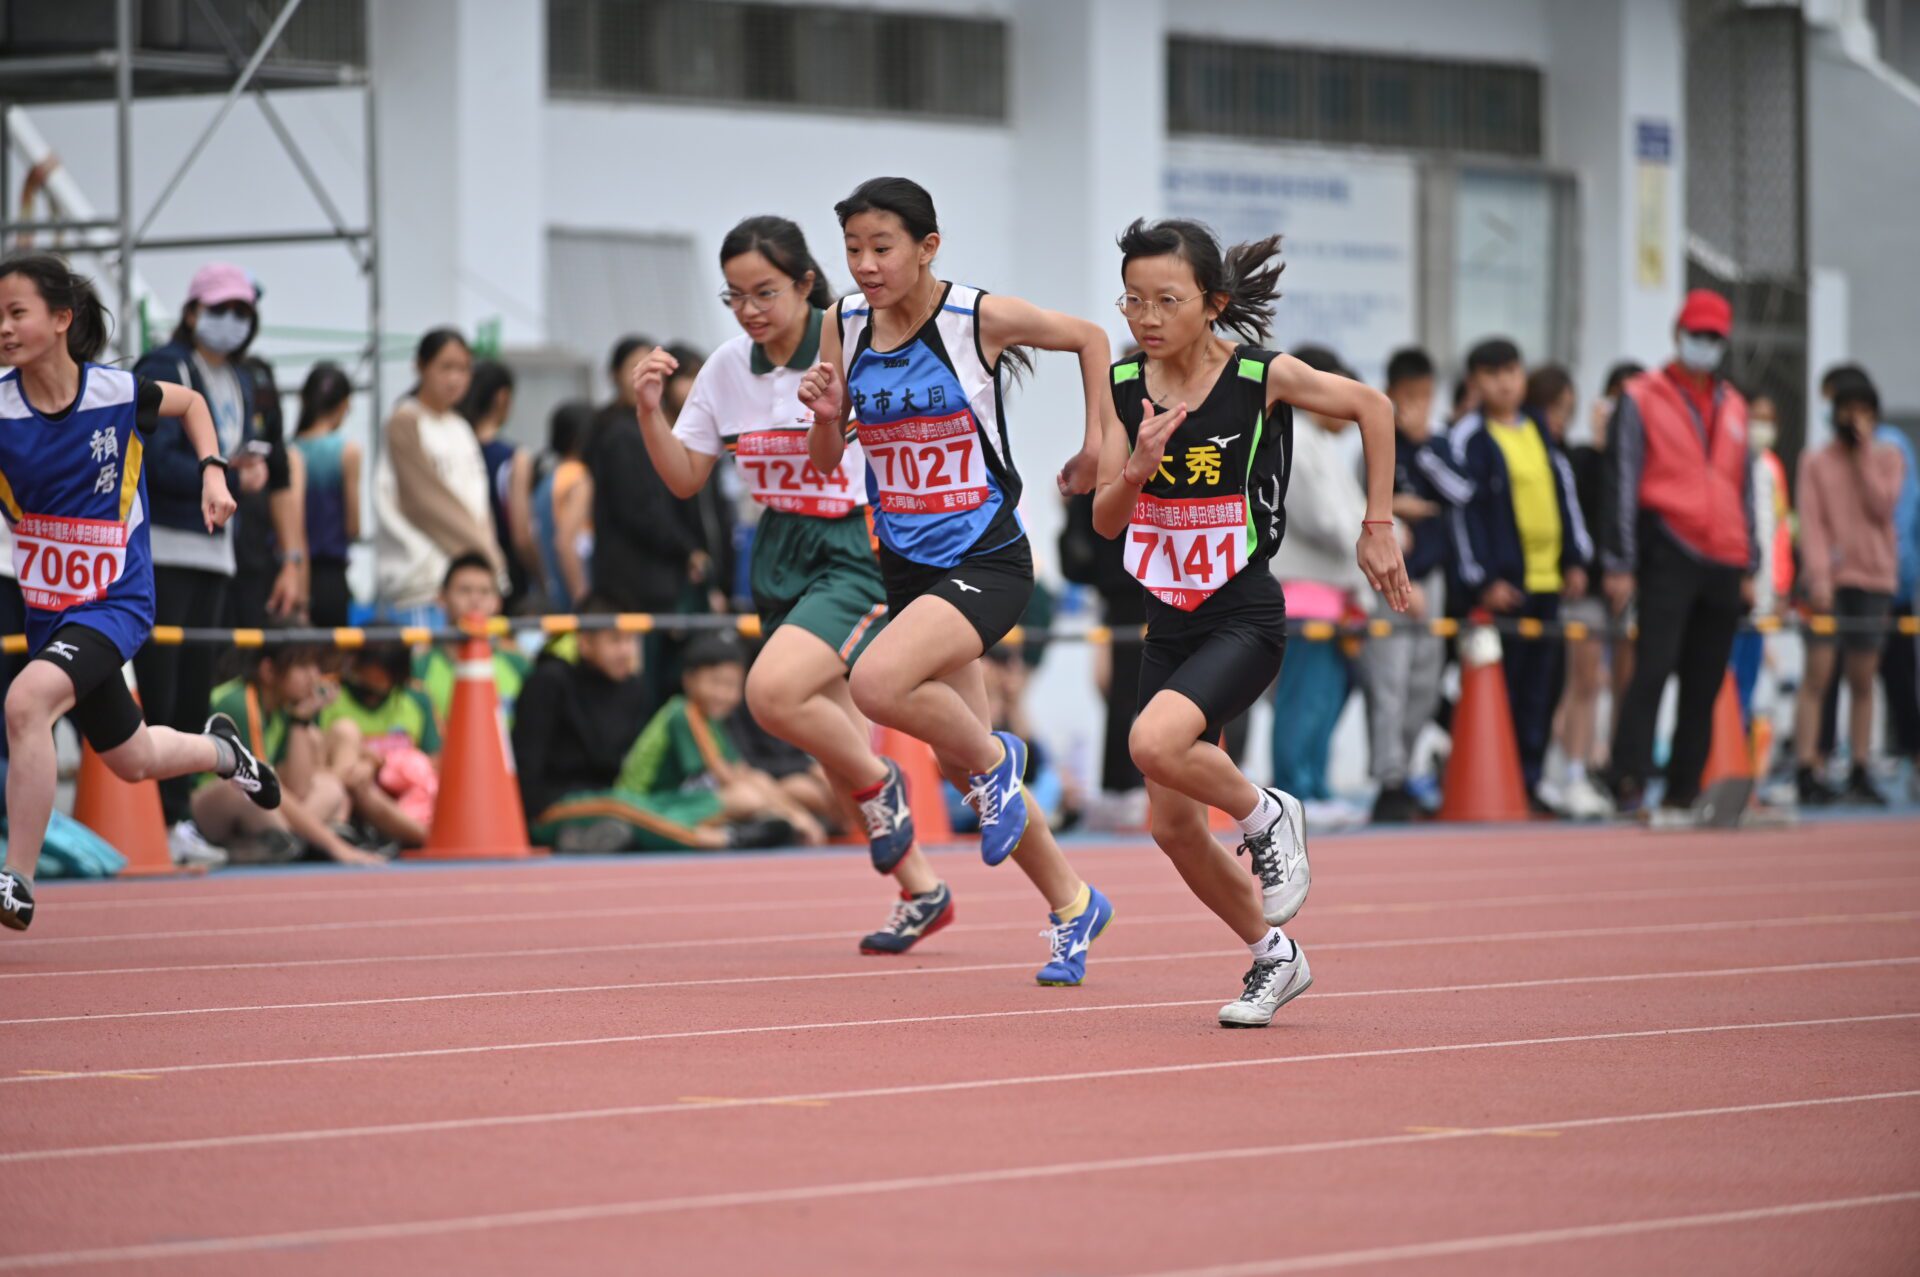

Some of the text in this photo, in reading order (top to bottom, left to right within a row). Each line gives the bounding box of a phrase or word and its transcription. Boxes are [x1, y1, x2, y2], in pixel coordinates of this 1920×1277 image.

[743, 459, 849, 493] 7244
[869, 438, 973, 490] 7027
[17, 541, 117, 591] 7060
[1132, 531, 1236, 584] 7141
